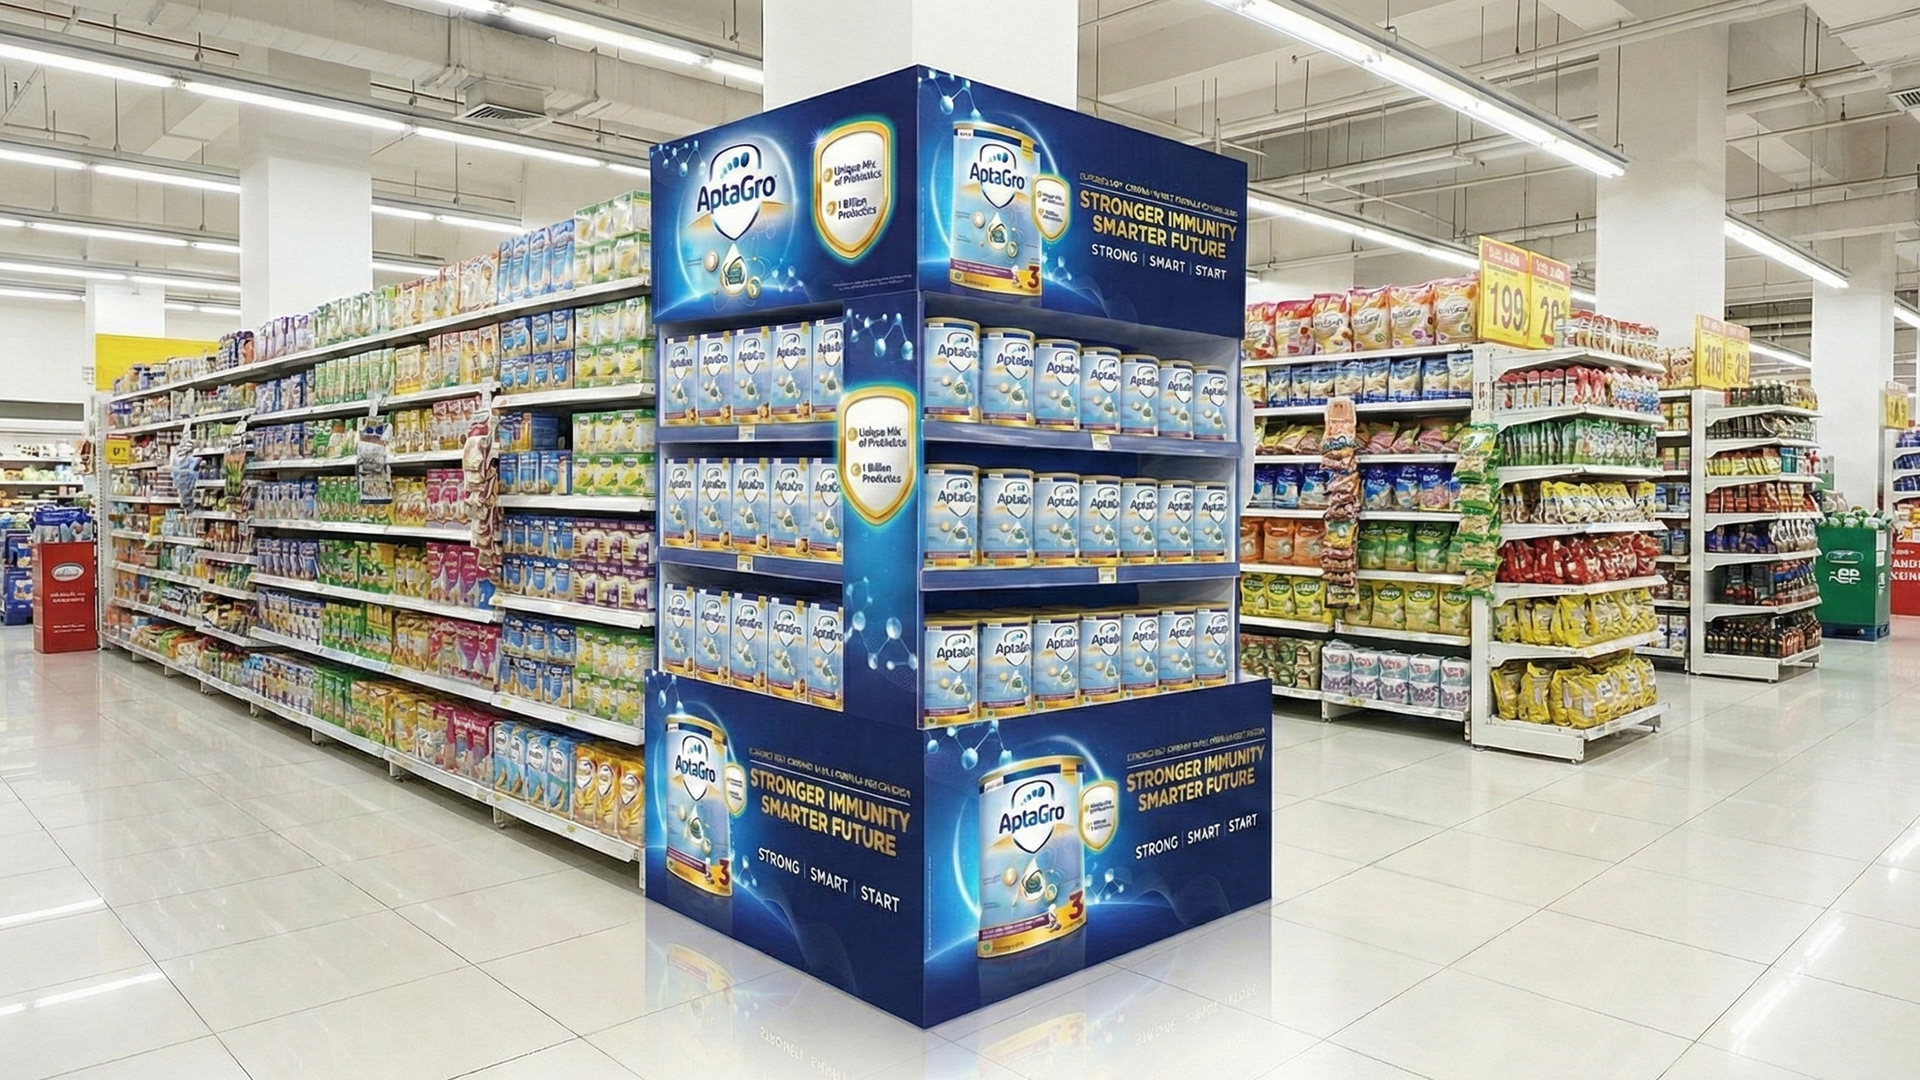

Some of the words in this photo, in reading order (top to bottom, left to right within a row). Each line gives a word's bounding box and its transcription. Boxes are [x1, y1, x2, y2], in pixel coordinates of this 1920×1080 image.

[697, 175, 776, 213] AptaGro
[970, 162, 1025, 190] AptaGro
[1080, 189, 1164, 226] STRONGER
[1168, 210, 1237, 242] IMMUNITY
[1093, 214, 1167, 247] SMARTER
[1171, 232, 1226, 259] FUTURE
[1028, 265, 1039, 288] 3
[1091, 243, 1138, 264] STRONG
[1149, 255, 1186, 273] SMART
[1195, 264, 1227, 280] START
[675, 754, 716, 783] AptaGro
[1126, 759, 1202, 793] STRONGER
[1204, 744, 1266, 774] IMMUNITY
[751, 768, 826, 808] STRONGER
[829, 790, 911, 833] IMMUNITY
[1138, 780, 1203, 812] SMARTER
[1206, 767, 1255, 796] FUTURE
[762, 795, 828, 834] SMARTER
[831, 816, 897, 857] FUTURE
[999, 803, 1065, 835] AptaGro
[1135, 835, 1179, 860] STRONG
[1187, 823, 1221, 845] SMART
[1228, 813, 1258, 833] START
[719, 859, 730, 886] 3
[758, 847, 800, 875] STRONG
[810, 867, 848, 893] SMART
[860, 885, 900, 913] START
[1069, 890, 1084, 920] 3
